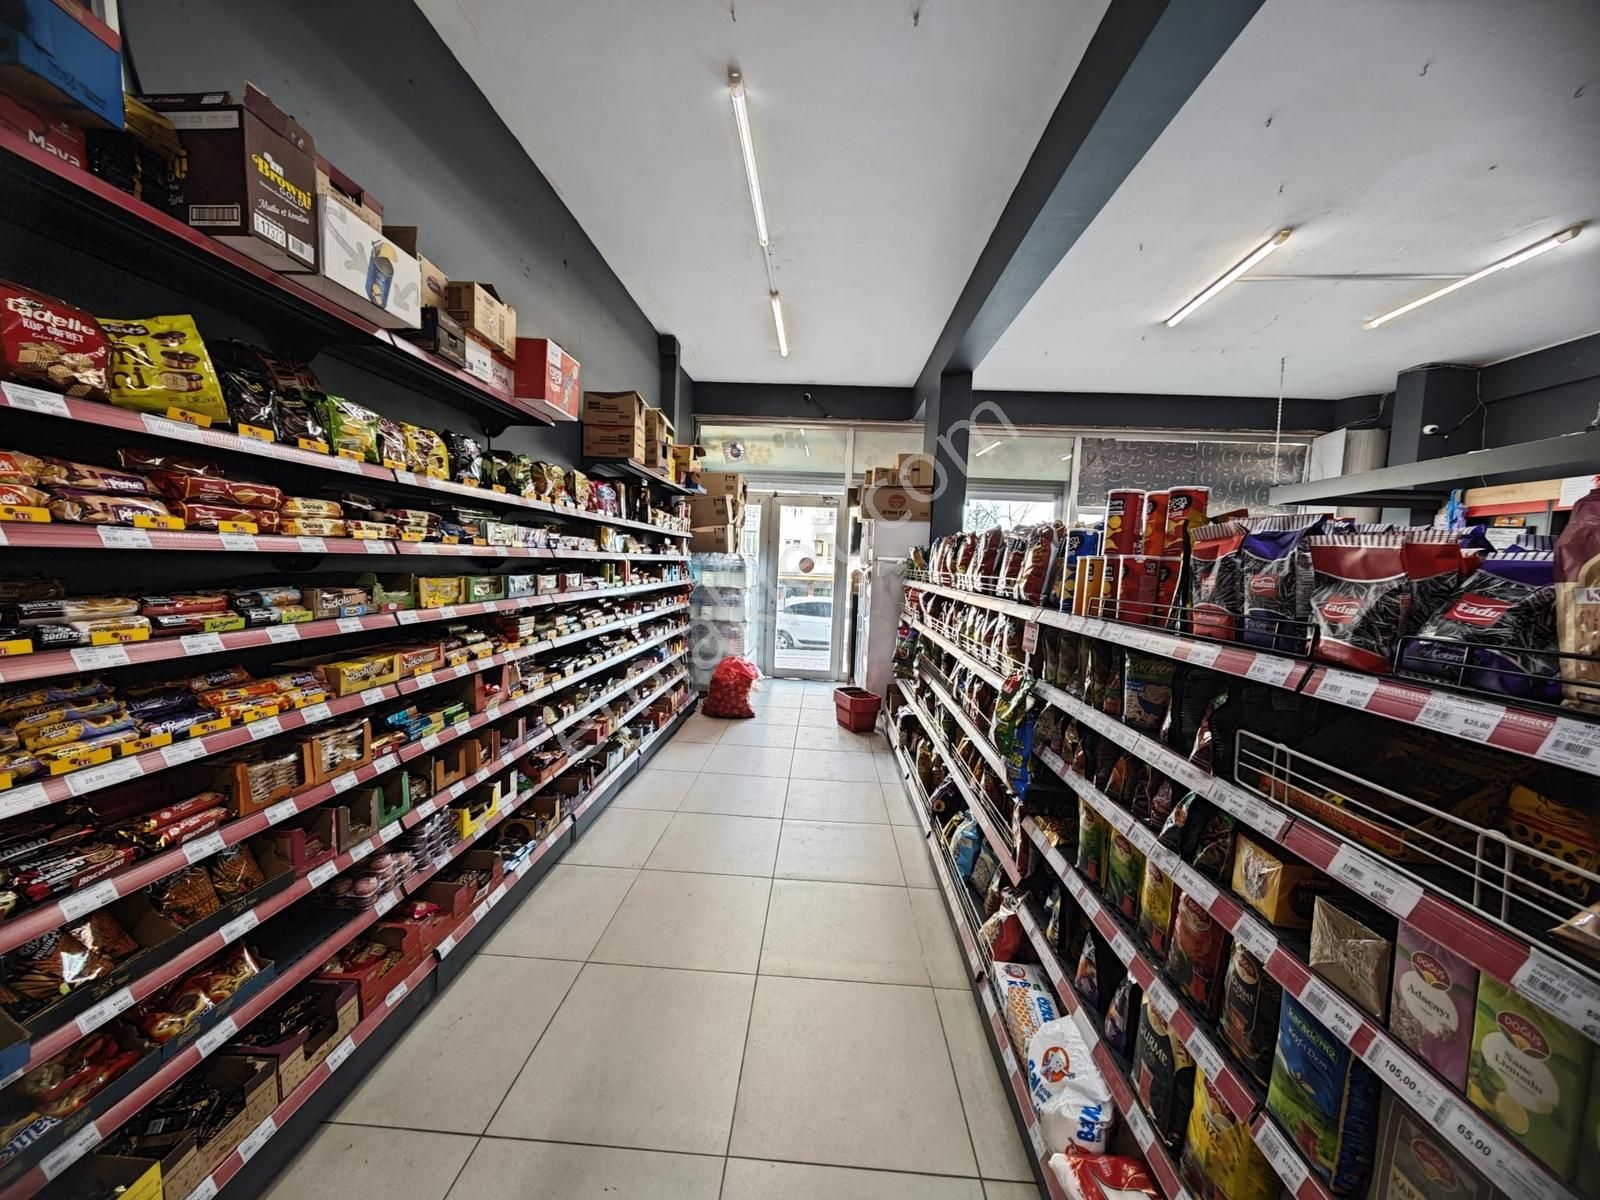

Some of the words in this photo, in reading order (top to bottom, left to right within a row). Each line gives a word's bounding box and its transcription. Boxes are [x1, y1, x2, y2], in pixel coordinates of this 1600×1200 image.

[252, 154, 312, 210] Browni
[280, 187, 304, 207] GOLD
[78, 858, 124, 887] Biscolata
[1140, 1022, 1168, 1067] GURME
[1384, 1060, 1416, 1090] 105,00
[1456, 1124, 1492, 1157] 65,00
